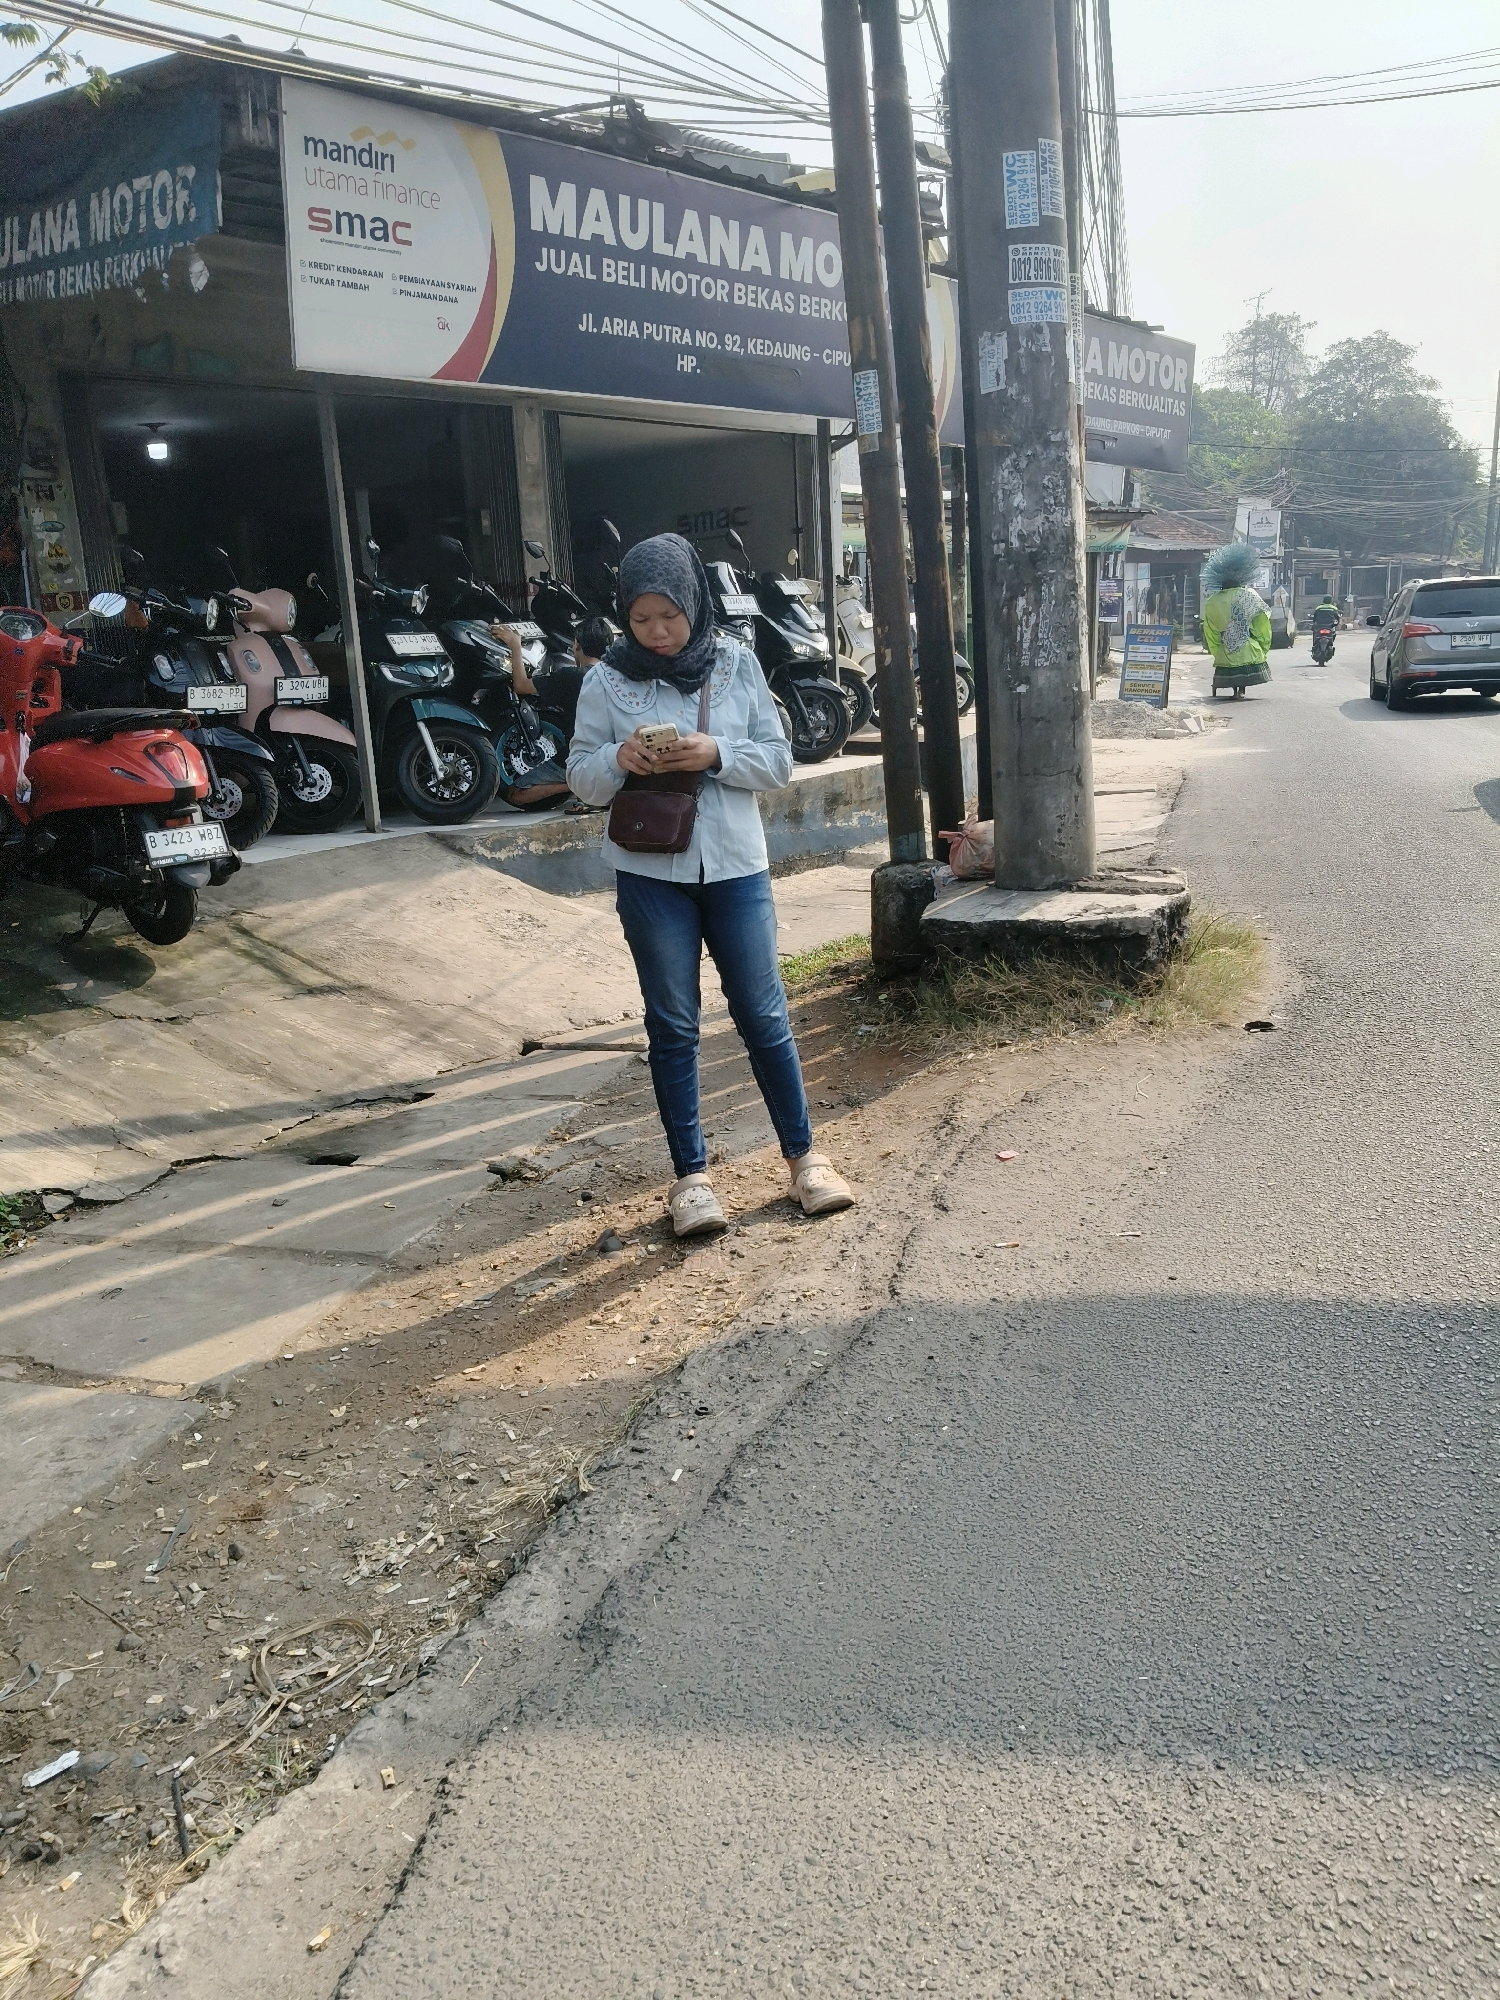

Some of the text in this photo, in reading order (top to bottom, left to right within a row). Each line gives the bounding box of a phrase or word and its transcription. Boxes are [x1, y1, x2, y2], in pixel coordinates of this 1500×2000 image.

[303, 135, 395, 173] mandiri
[1040, 141, 1047, 175] WC
[304, 166, 441, 209] utama finance
[1005, 153, 1017, 225] SEDOT WC
[1017, 153, 1031, 225] 0812 9264 9141
[89, 163, 196, 247] MOTOR
[307, 206, 413, 247] smac
[529, 174, 772, 276] MAULANA
[308, 261, 384, 279] KREDIT KENDARAAN
[534, 247, 597, 280] JUAL
[602, 257, 646, 288] BELI
[651, 266, 730, 303] MOTOR
[733, 282, 795, 314] BEKAS
[1011, 257, 1032, 281] 0812
[1033, 256, 1052, 281] 9916
[309, 275, 370, 291] TUKAR TAMBAH
[399, 274, 477, 293] PEMBIAYAAN SYARIAH
[1011, 290, 1066, 301] SEDOT WC
[399, 288, 459, 304] PINJAMAN DANA
[1010, 302, 1031, 316] 0812
[1033, 301, 1053, 314] 9264
[601, 316, 640, 338] ARIA
[643, 321, 692, 346] PUTRA
[695, 329, 722, 350] NO.
[724, 333, 745, 355] 92,
[747, 337, 811, 361] KEDAUNG
[677, 353, 701, 374] HP.
[1084, 336, 1188, 394] A MOTOR
[854, 374, 863, 402] WC
[860, 372, 872, 391] 9141
[1083, 380, 1186, 417] BEKAS BERKUALITAS
[865, 412, 876, 432] 0812
[1145, 425, 1172, 440] CIPUTAT
[676, 505, 749, 536] smac
[1136, 635, 1160, 643] CELL
[189, 688, 196, 700] B
[278, 681, 284, 692] B
[148, 835, 158, 849] B
[161, 830, 193, 847] 3423
